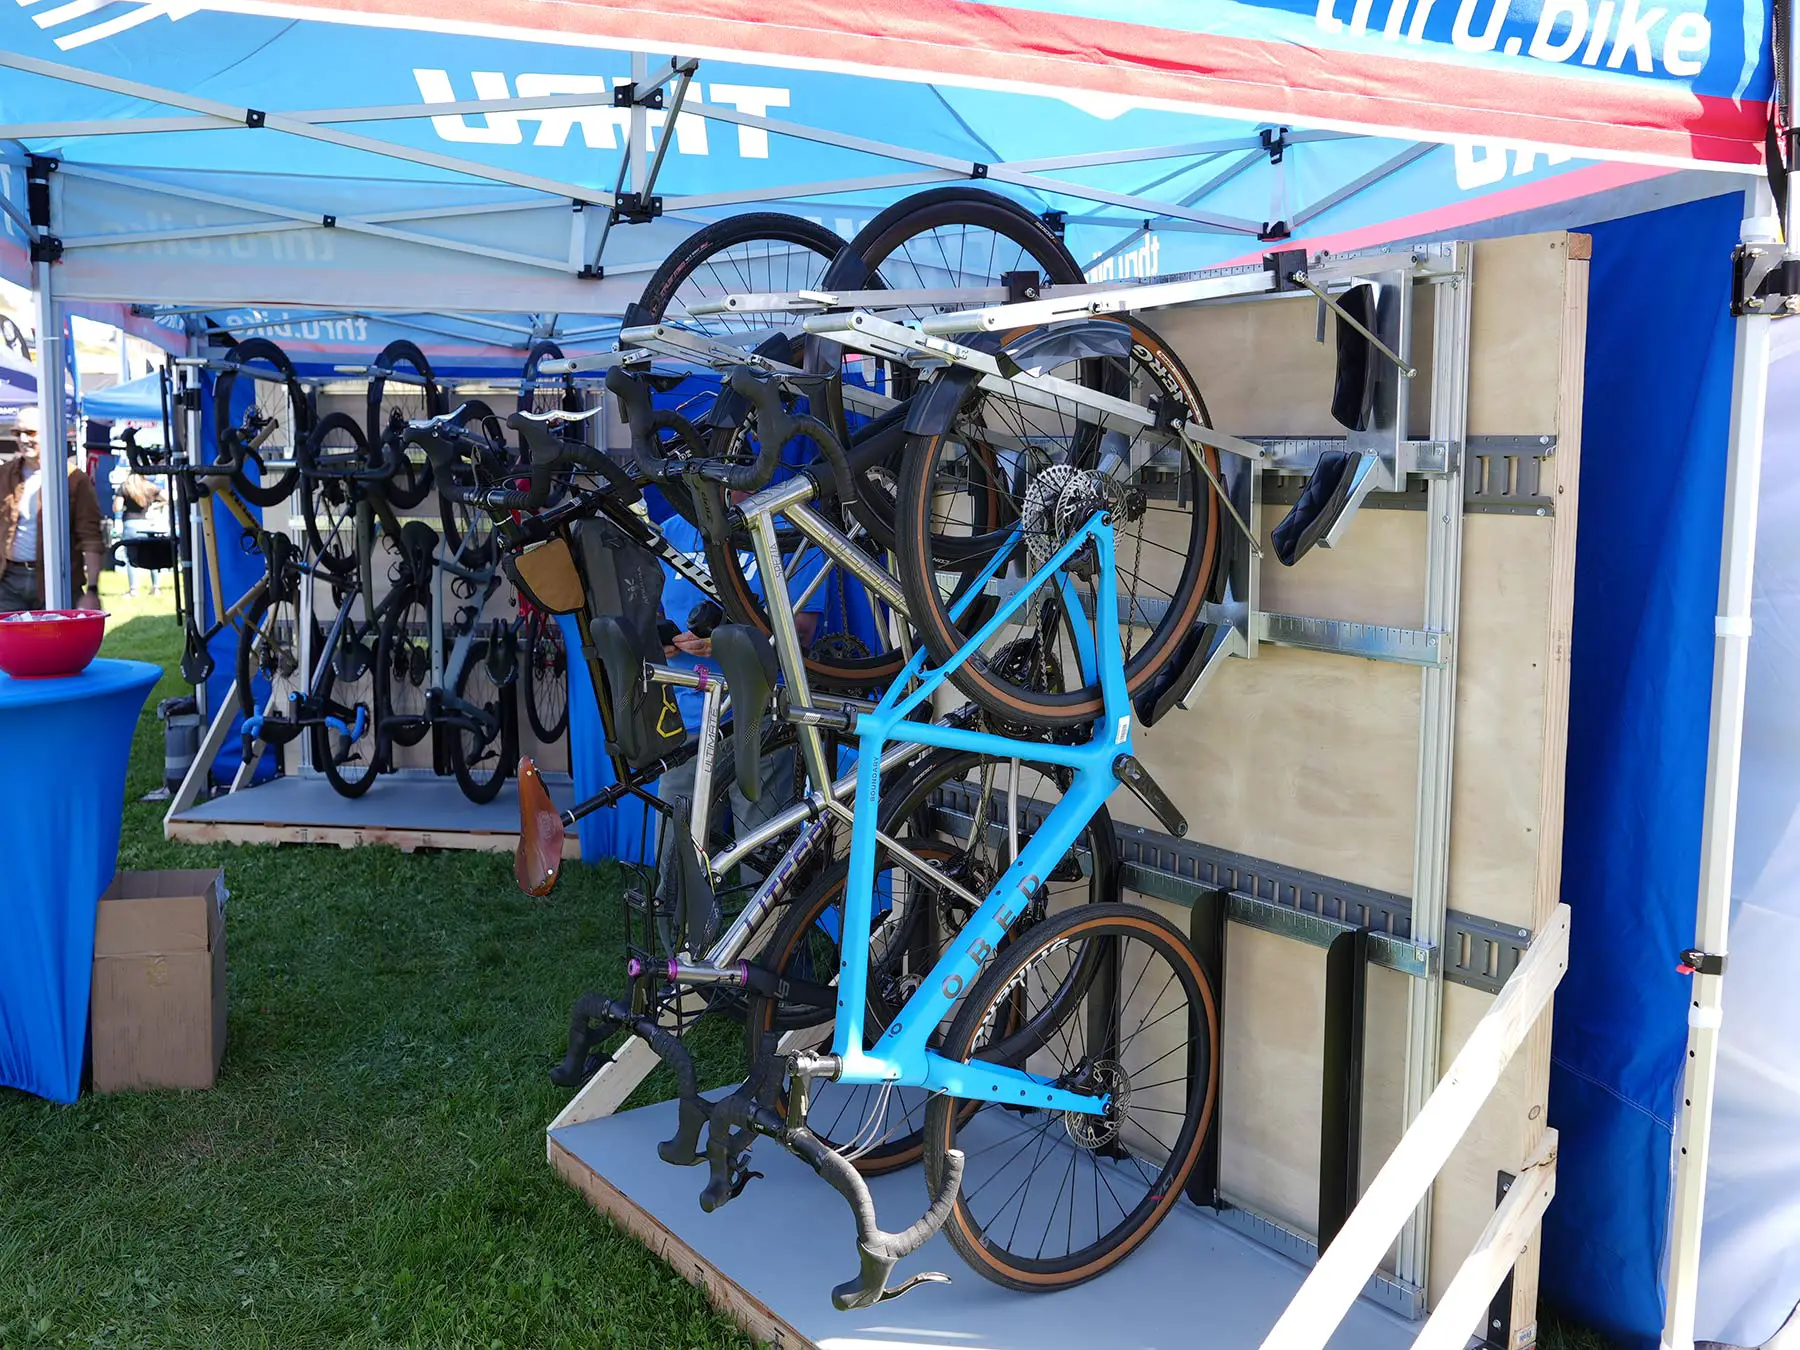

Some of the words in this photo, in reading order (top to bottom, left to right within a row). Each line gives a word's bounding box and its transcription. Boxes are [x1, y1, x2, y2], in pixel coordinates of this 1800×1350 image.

[704, 708, 719, 774] ULTIMATE
[870, 757, 879, 802] BOUNDARY
[942, 874, 1041, 999] OBED
